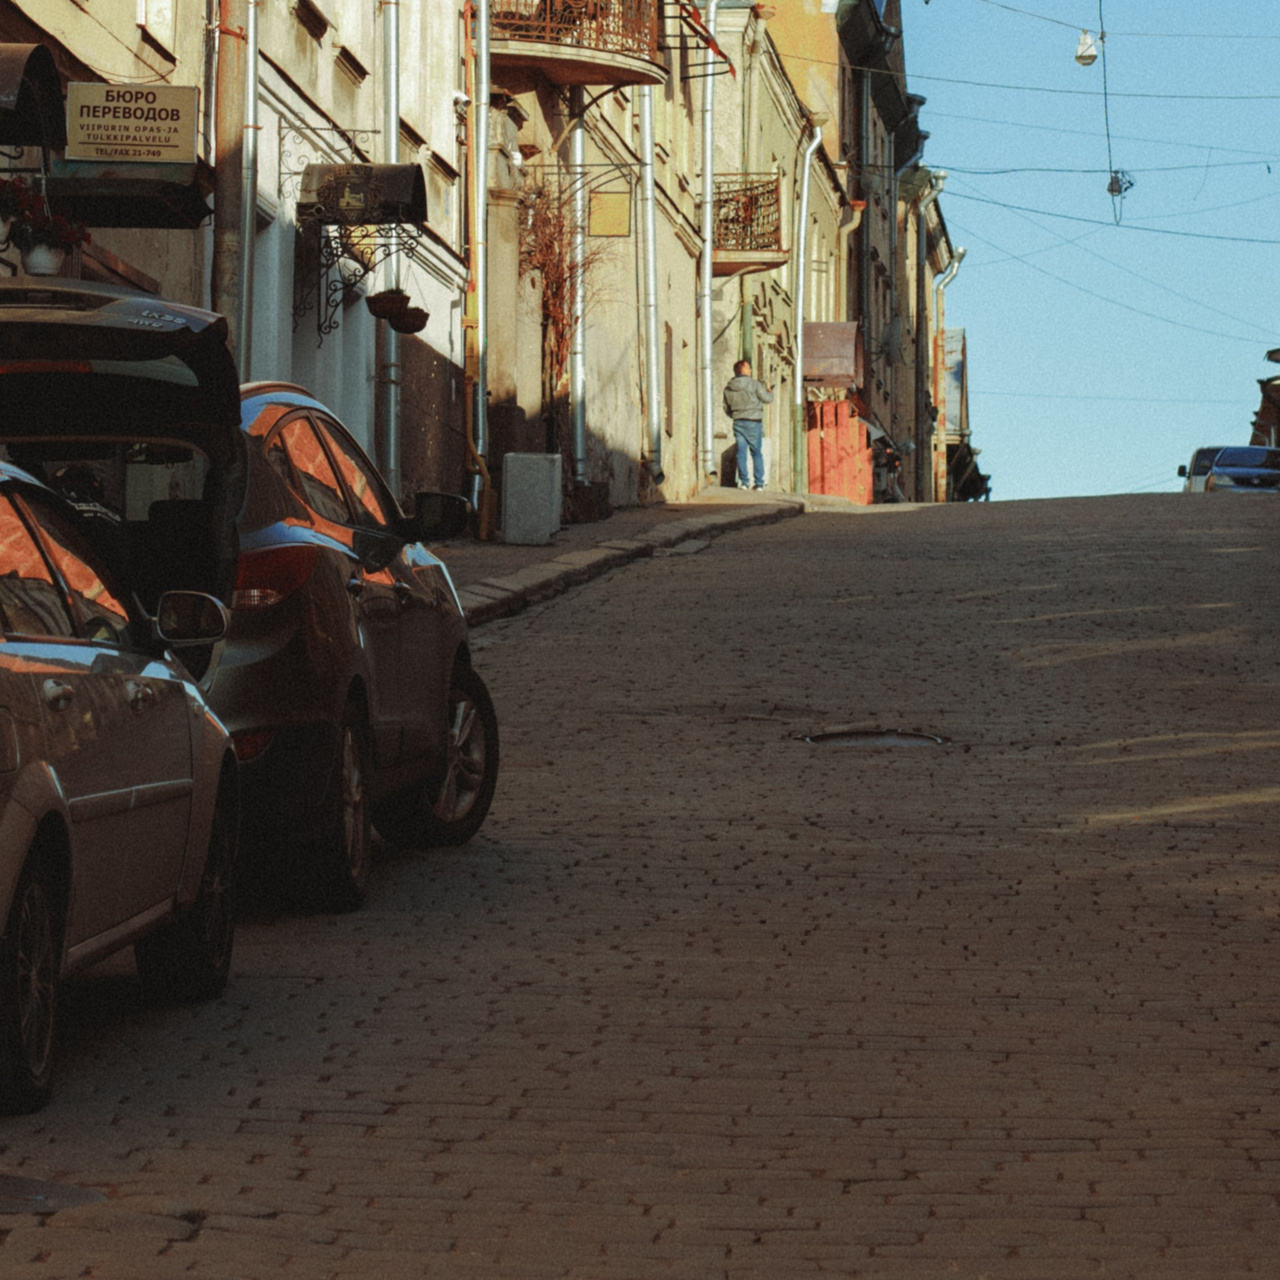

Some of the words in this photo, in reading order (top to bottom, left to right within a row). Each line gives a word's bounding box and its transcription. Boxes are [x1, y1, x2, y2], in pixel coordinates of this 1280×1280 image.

[105, 90, 157, 104] БЮРО
[79, 105, 180, 122] ПЕРЕВОДОВ
[79, 124, 130, 132] VIIPURIN
[134, 125, 179, 134] OPAS-JA
[86, 133, 171, 143] TULKKIPALVELU
[94, 148, 130, 157] TEL/FAX
[132, 149, 161, 157] 21-749
